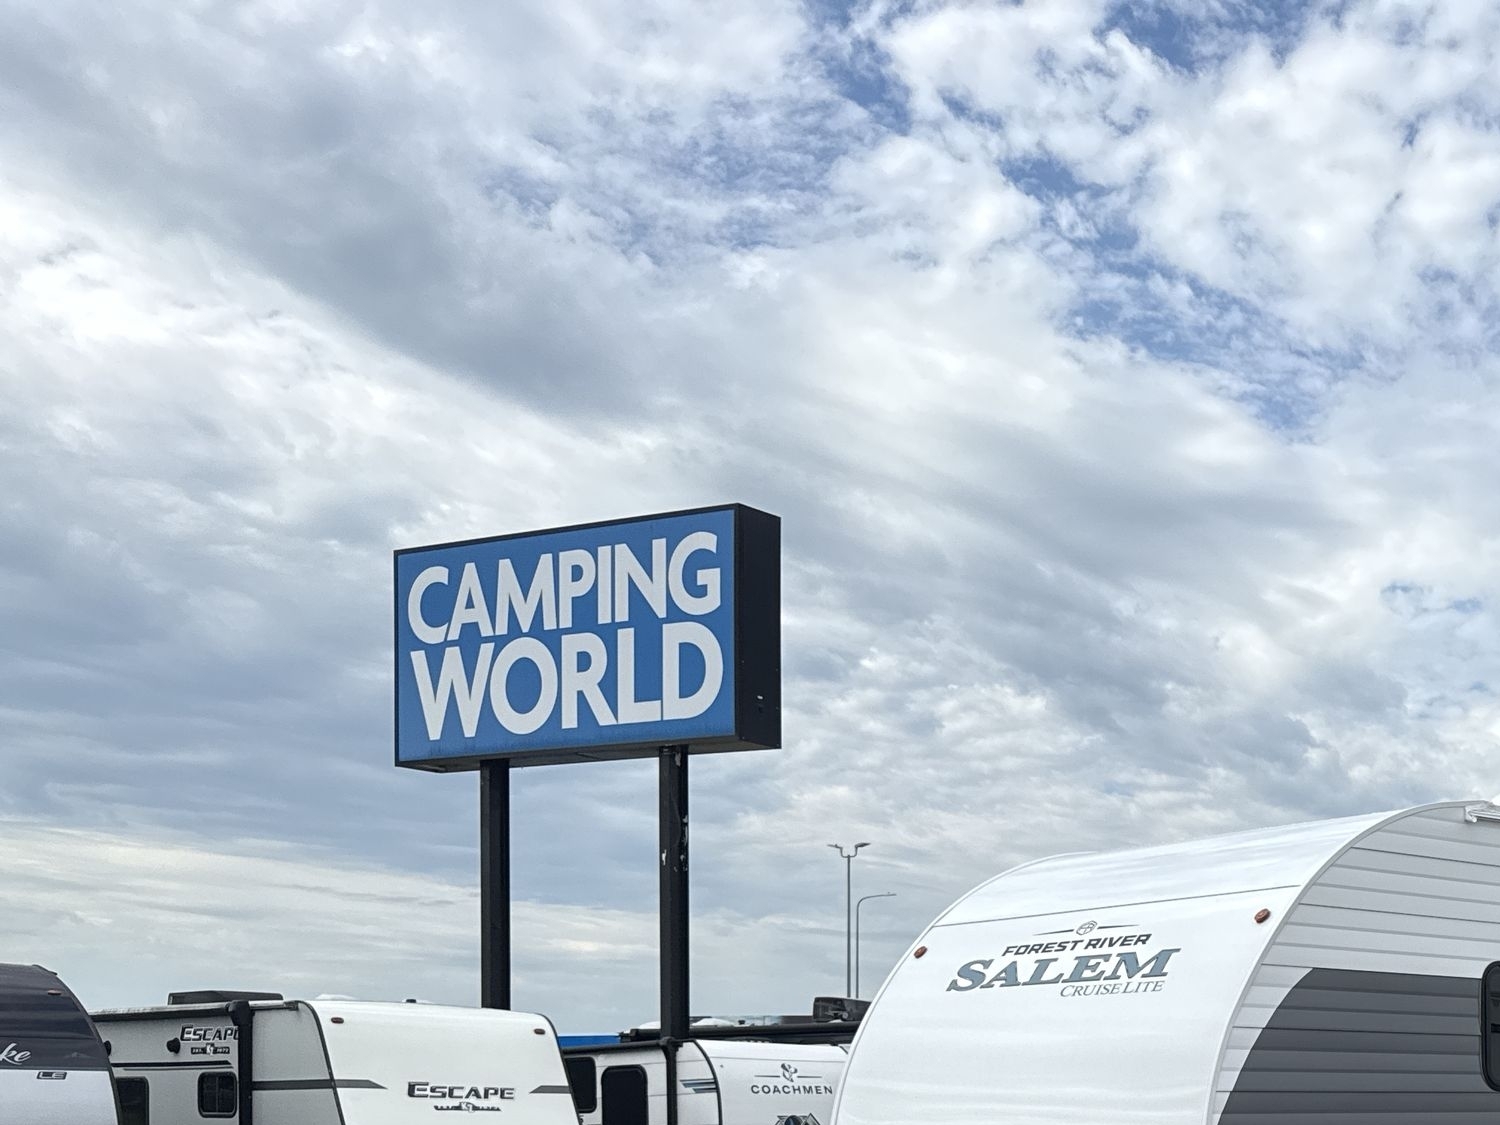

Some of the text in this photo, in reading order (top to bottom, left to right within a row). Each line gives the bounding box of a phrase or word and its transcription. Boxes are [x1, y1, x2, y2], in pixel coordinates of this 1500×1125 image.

[408, 531, 721, 644] CAMPING
[410, 621, 723, 741] WORLD
[1002, 934, 1152, 957] FOREST RIVER
[946, 948, 1181, 992] SALEM
[407, 1081, 515, 1100] ESCAPE
[750, 1084, 833, 1095] COACHMEN
